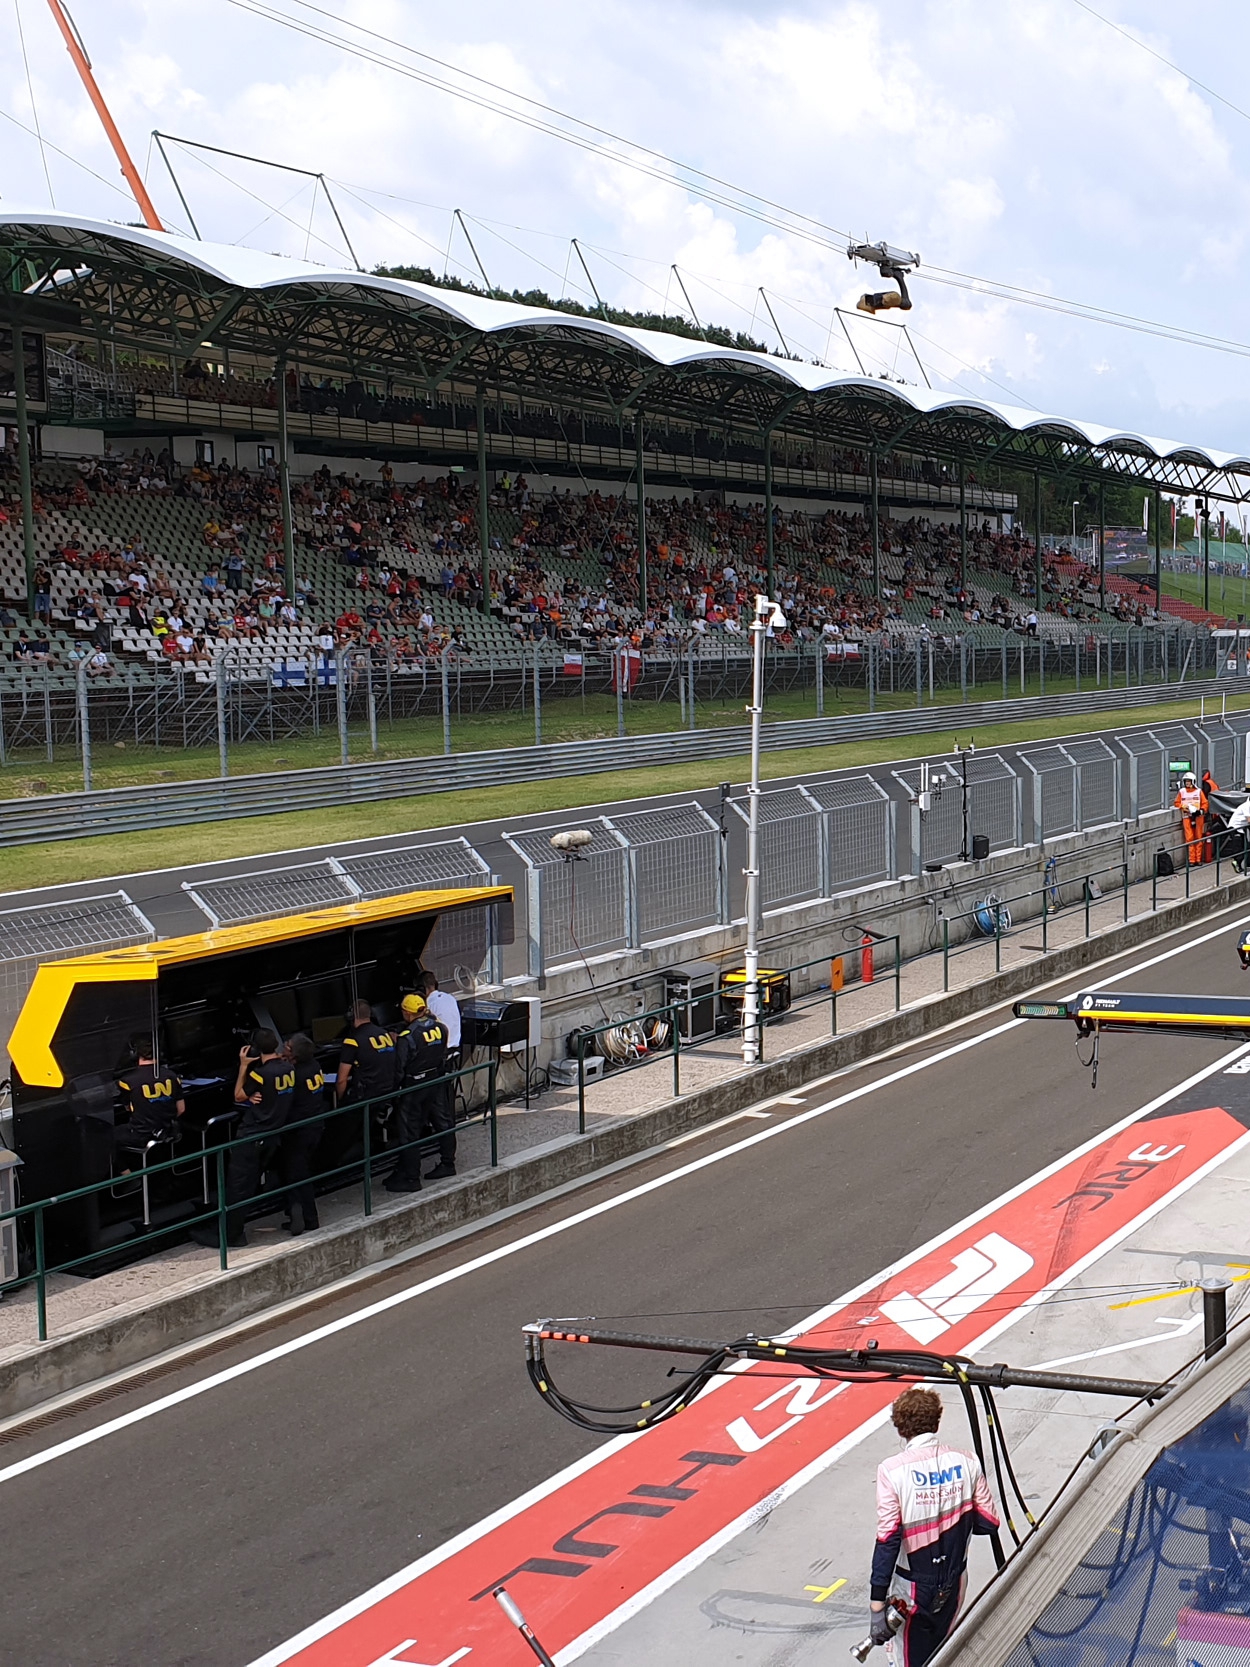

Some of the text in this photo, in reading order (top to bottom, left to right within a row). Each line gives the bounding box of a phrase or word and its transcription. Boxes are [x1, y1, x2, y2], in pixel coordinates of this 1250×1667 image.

[1051, 1161, 1146, 1212] RIC
[467, 1377, 853, 1602] 27 HUL
[928, 1464, 962, 1486] BWT
